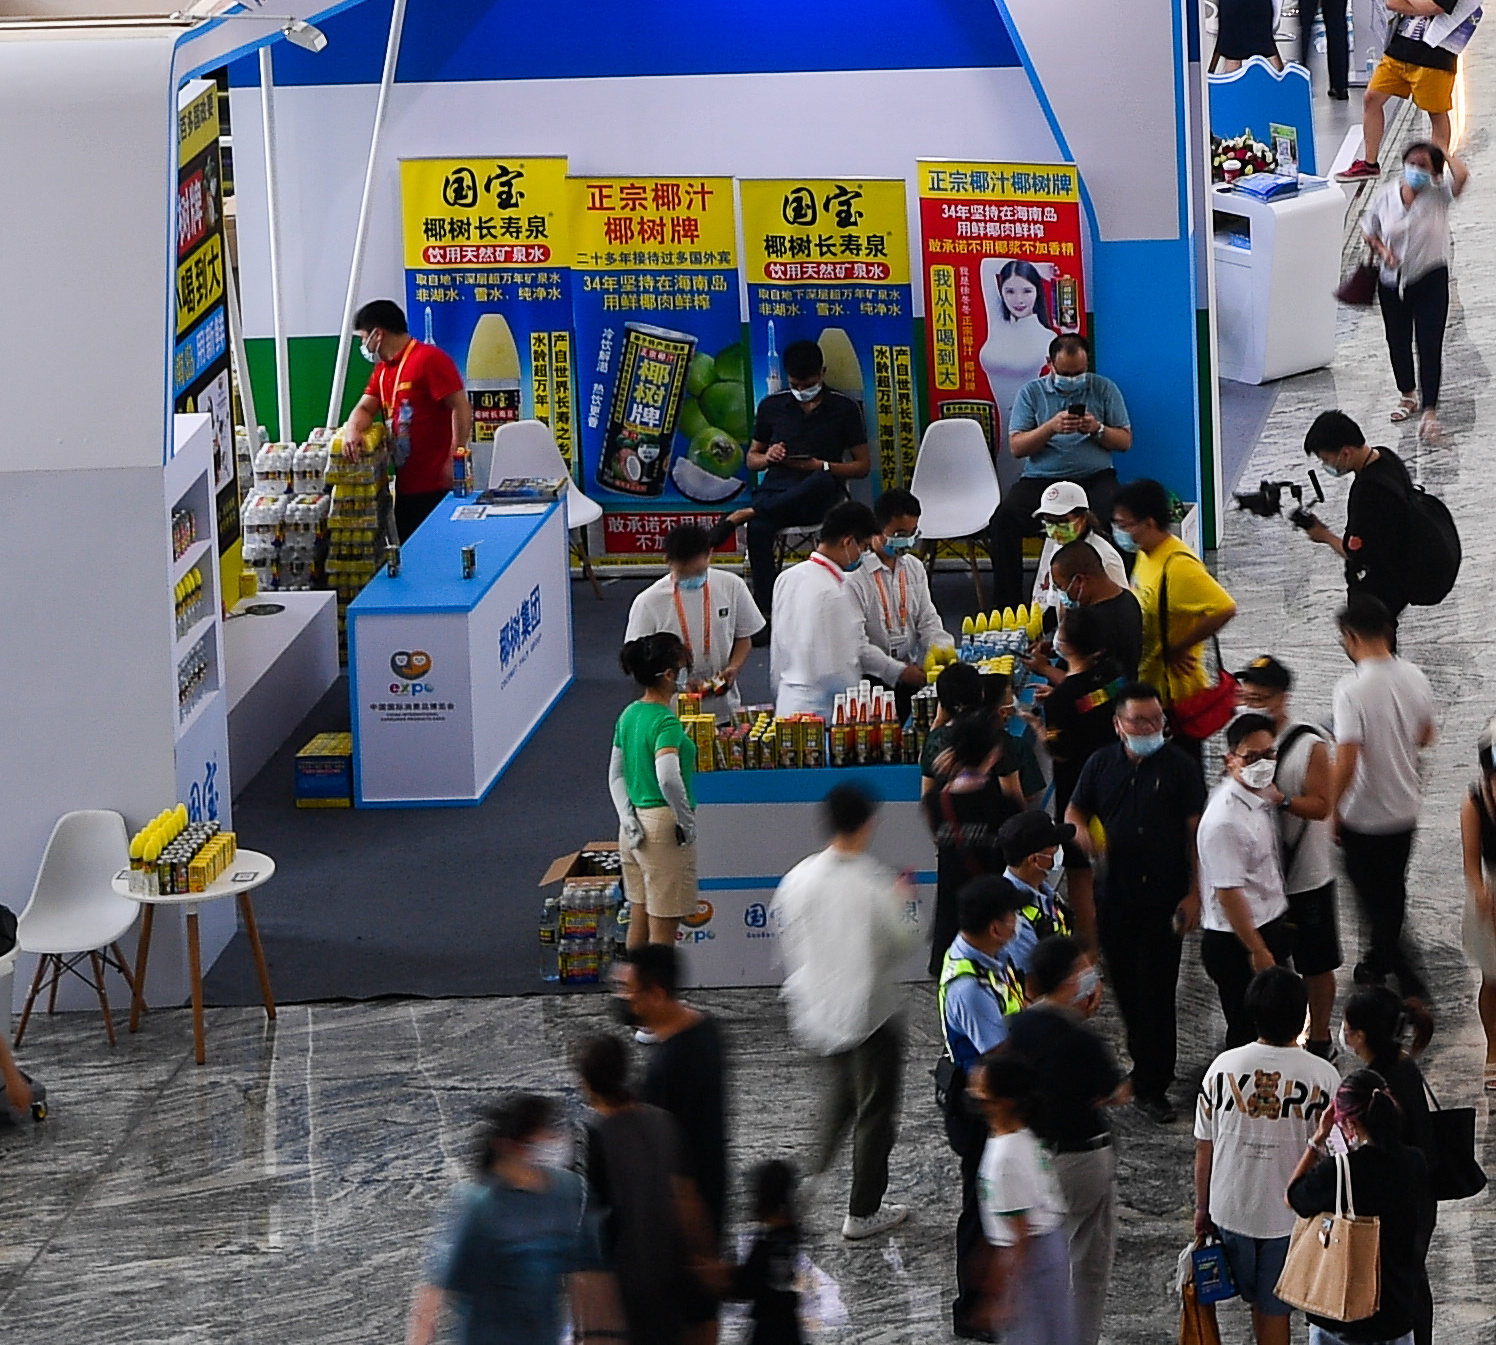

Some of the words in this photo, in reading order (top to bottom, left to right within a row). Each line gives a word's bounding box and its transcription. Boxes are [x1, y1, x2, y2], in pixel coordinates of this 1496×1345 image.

[442, 164, 525, 211] 国宝
[928, 169, 1073, 197] 正宗椰汁椰树牌
[586, 182, 714, 212] 正宗椰汁
[782, 184, 864, 228] 国宝
[941, 204, 1058, 223] 34年坚持在海南岛
[422, 215, 549, 242] 椰树长寿泉
[603, 216, 701, 246] 椰树牌
[956, 222, 1045, 239] 用鲜椰肉鲜榨
[427, 246, 546, 263] 饮用天然矿泉水
[763, 233, 889, 259] 椰树长寿泉
[928, 239, 1075, 257] 敢承诺不用椰浆不加香精
[416, 272, 562, 285] 取自地下深层超万年矿泉水
[582, 275, 728, 293] 34年坚持在海南岛
[769, 263, 885, 280] 饮用天然矿泉水
[603, 294, 711, 311] 用鲜椰肉鲜榨
[934, 268, 957, 386] 我从小喝到大
[532, 334, 549, 407] 水龄超万年
[874, 346, 893, 416] 水龄超万年
[629, 358, 671, 427] 椰树牌
[607, 515, 723, 533] 敢承诺不用椰
[388, 682, 435, 697] expo
